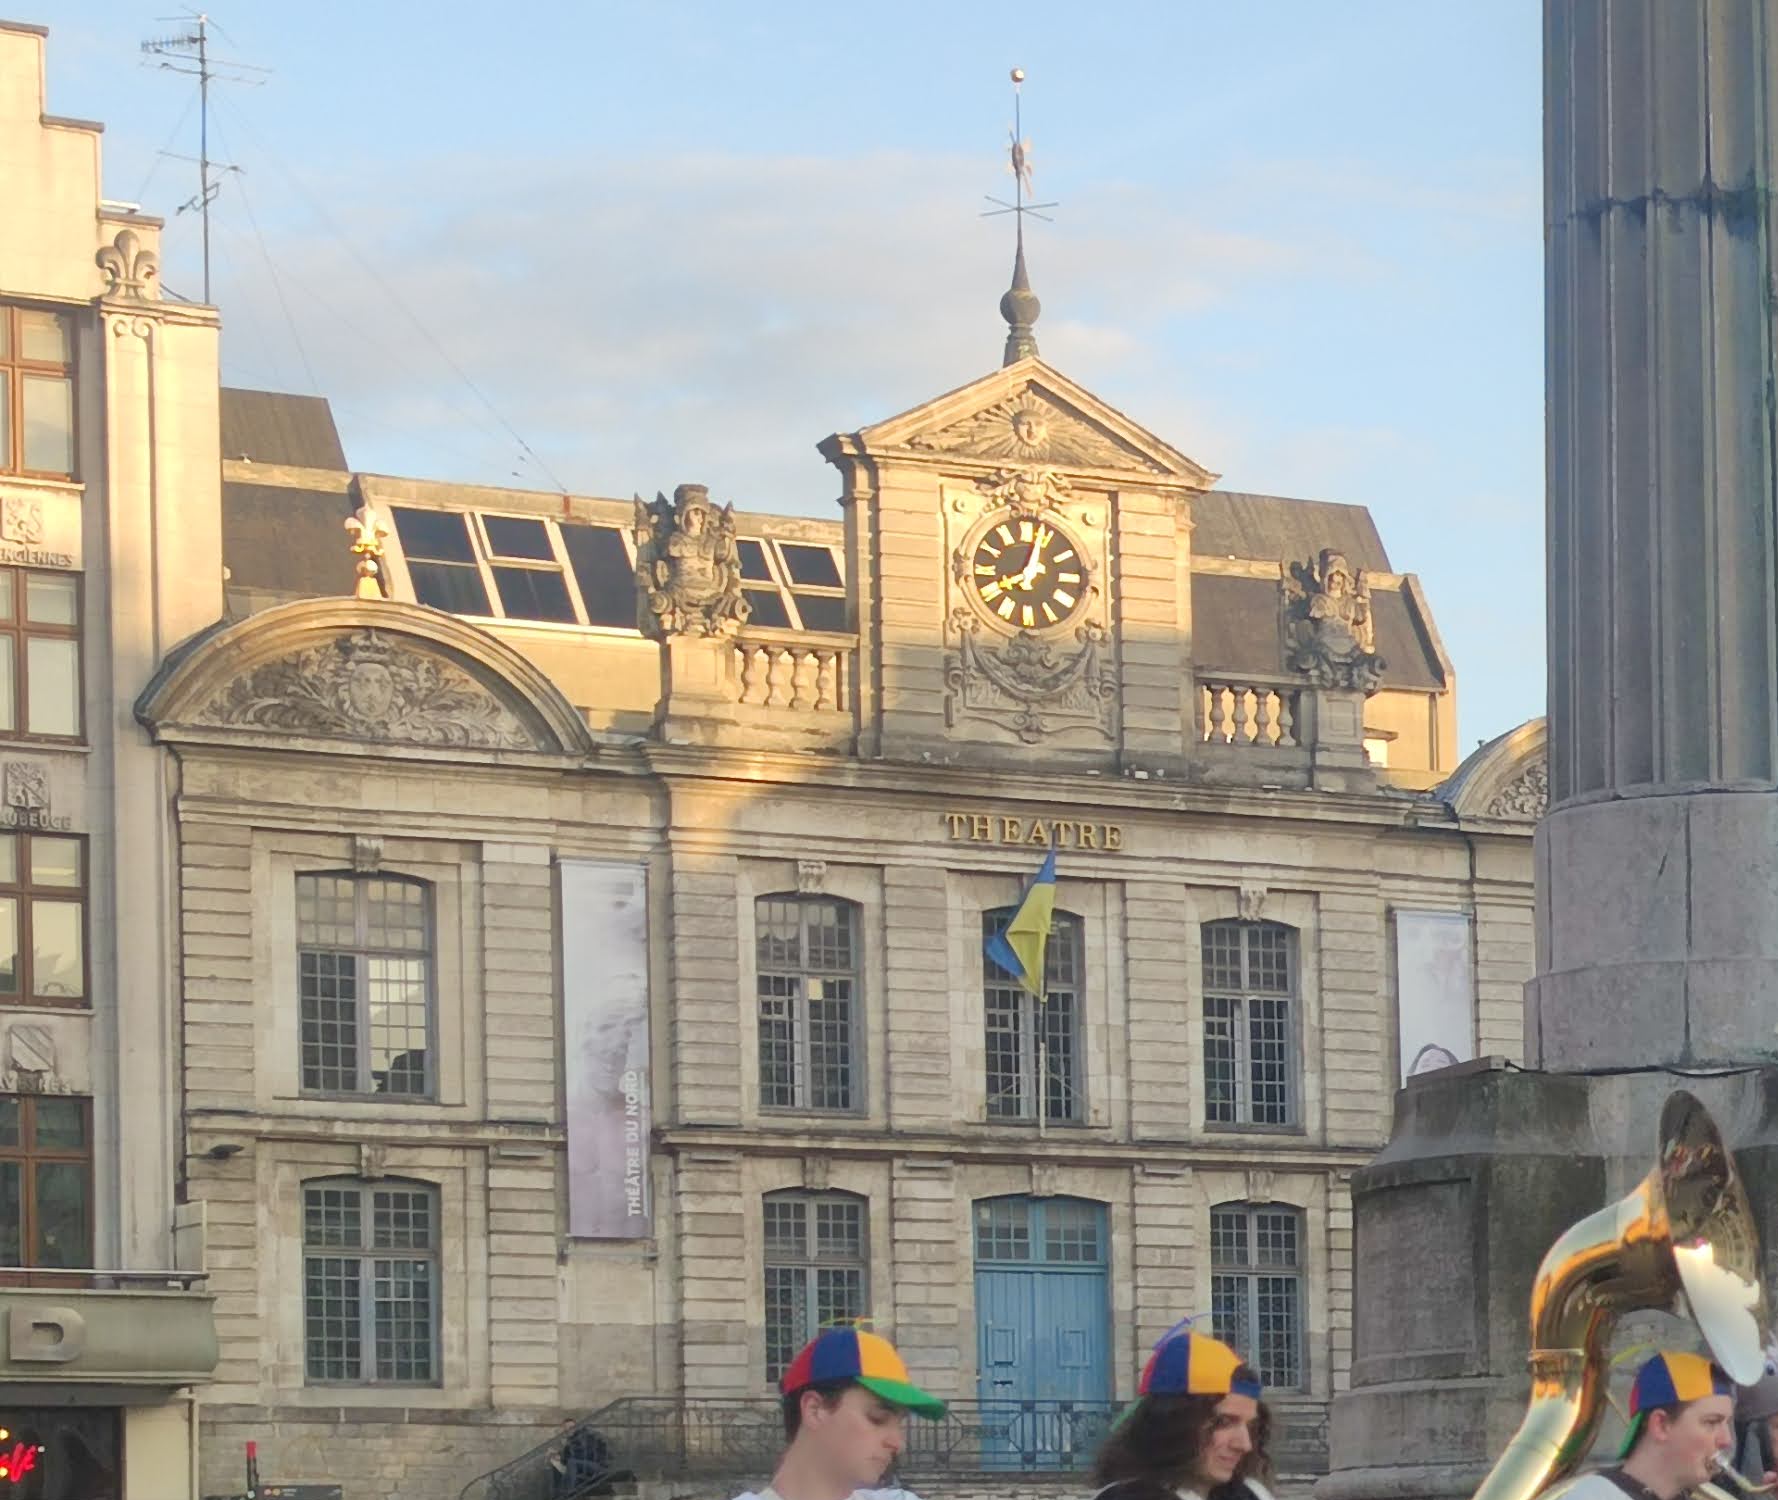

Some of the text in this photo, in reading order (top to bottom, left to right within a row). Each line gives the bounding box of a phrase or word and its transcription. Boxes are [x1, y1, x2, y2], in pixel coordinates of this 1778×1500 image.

[945, 813, 1124, 850] THEATRE
[625, 1071, 640, 1116] NORD
[626, 1120, 640, 1143] DU
